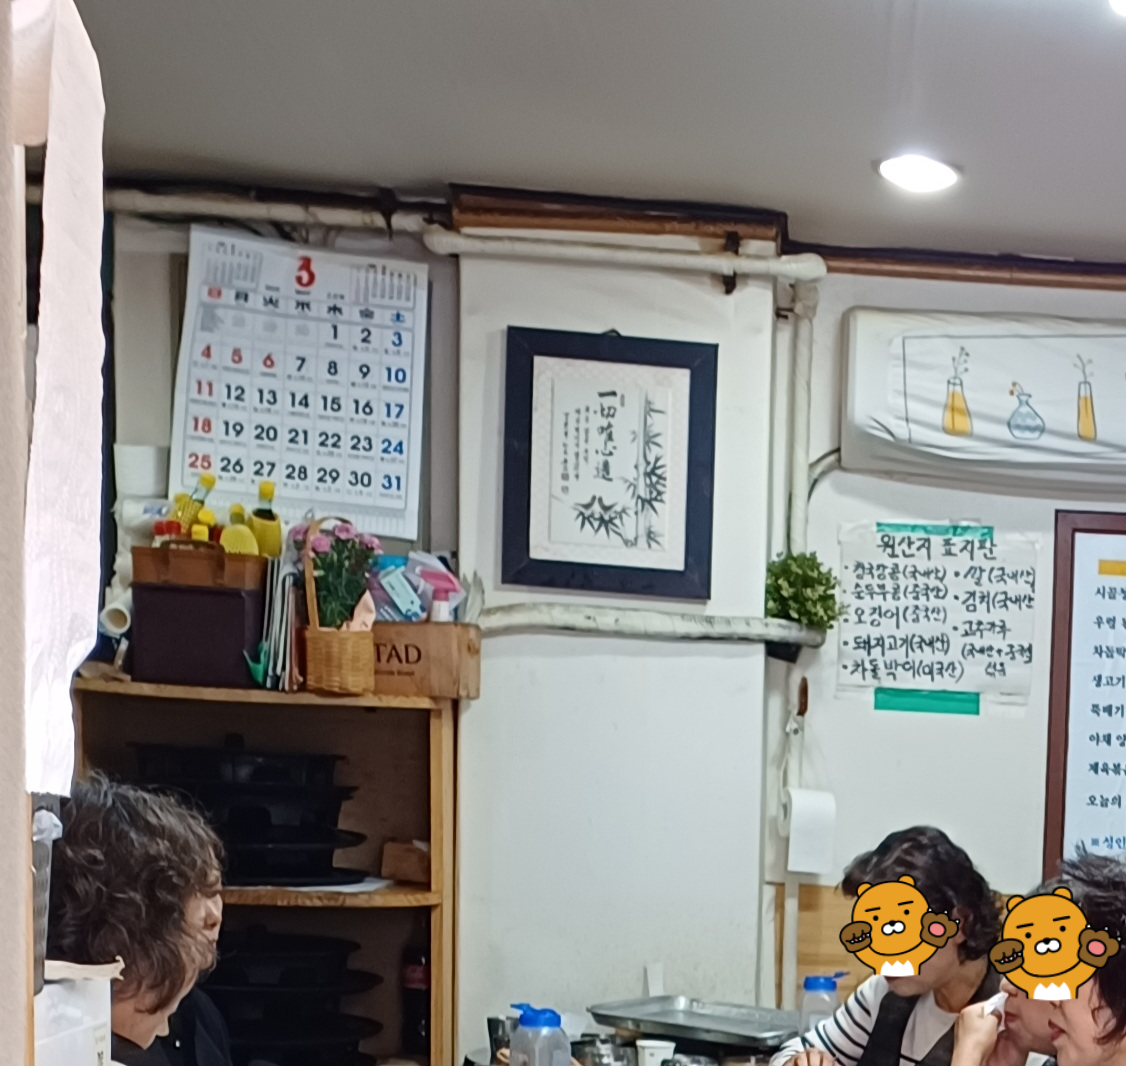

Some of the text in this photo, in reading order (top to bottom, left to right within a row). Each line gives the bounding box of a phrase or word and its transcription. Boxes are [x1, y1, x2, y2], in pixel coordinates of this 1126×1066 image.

[295, 255, 316, 288] 3
[331, 324, 403, 347] 1 2 3
[201, 344, 407, 384] 4 5 6 7 8 9 10
[196, 380, 405, 419] 11 12 13 14 15 16 17
[192, 417, 404, 455] 18 19 20 21 22 23 24
[188, 453, 402, 491] 25 26 27 28 29 30 31
[877, 534, 998, 561] 원산지 표지판
[1086, 793, 1123, 809] 오늘의
